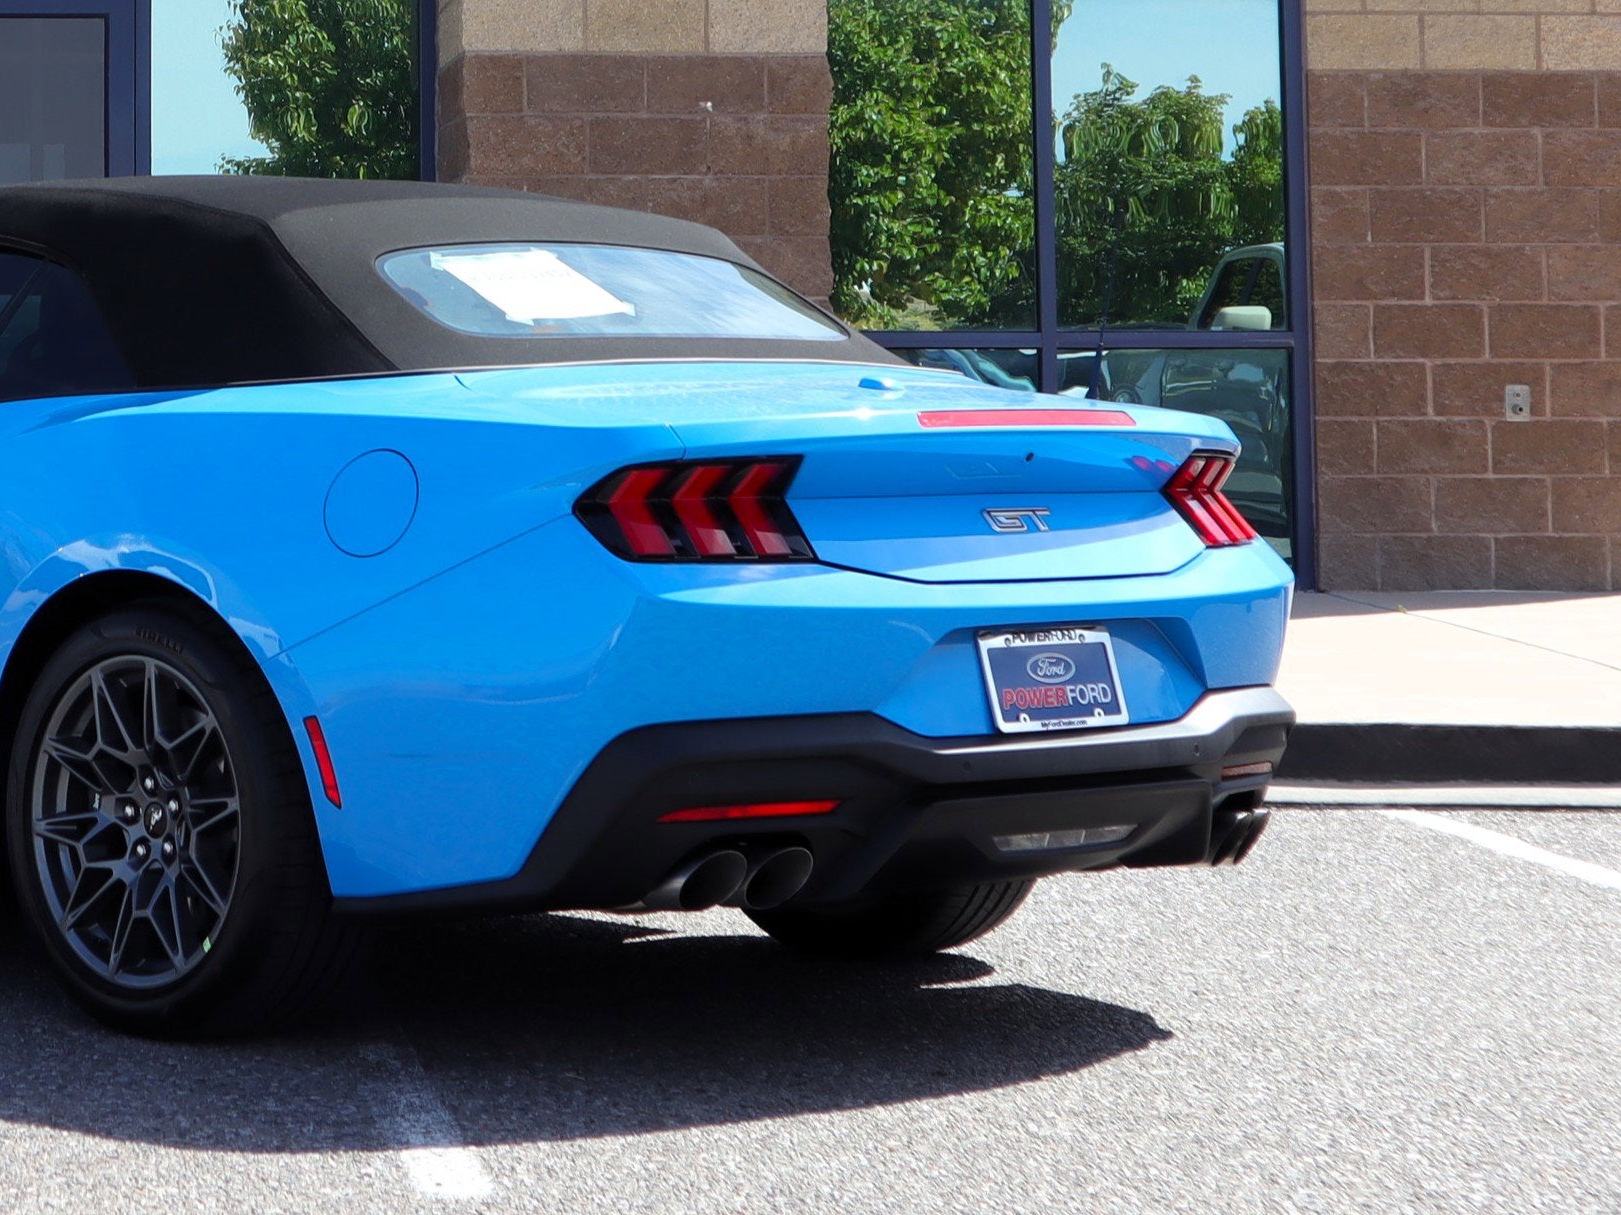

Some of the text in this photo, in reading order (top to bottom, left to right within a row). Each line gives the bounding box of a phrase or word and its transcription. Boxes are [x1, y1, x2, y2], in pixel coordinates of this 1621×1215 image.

[982, 507, 1051, 533] GT
[1012, 629, 1077, 644] POWERFORD
[1036, 658, 1066, 677] Ford
[1002, 683, 1112, 710] POWERFORD
